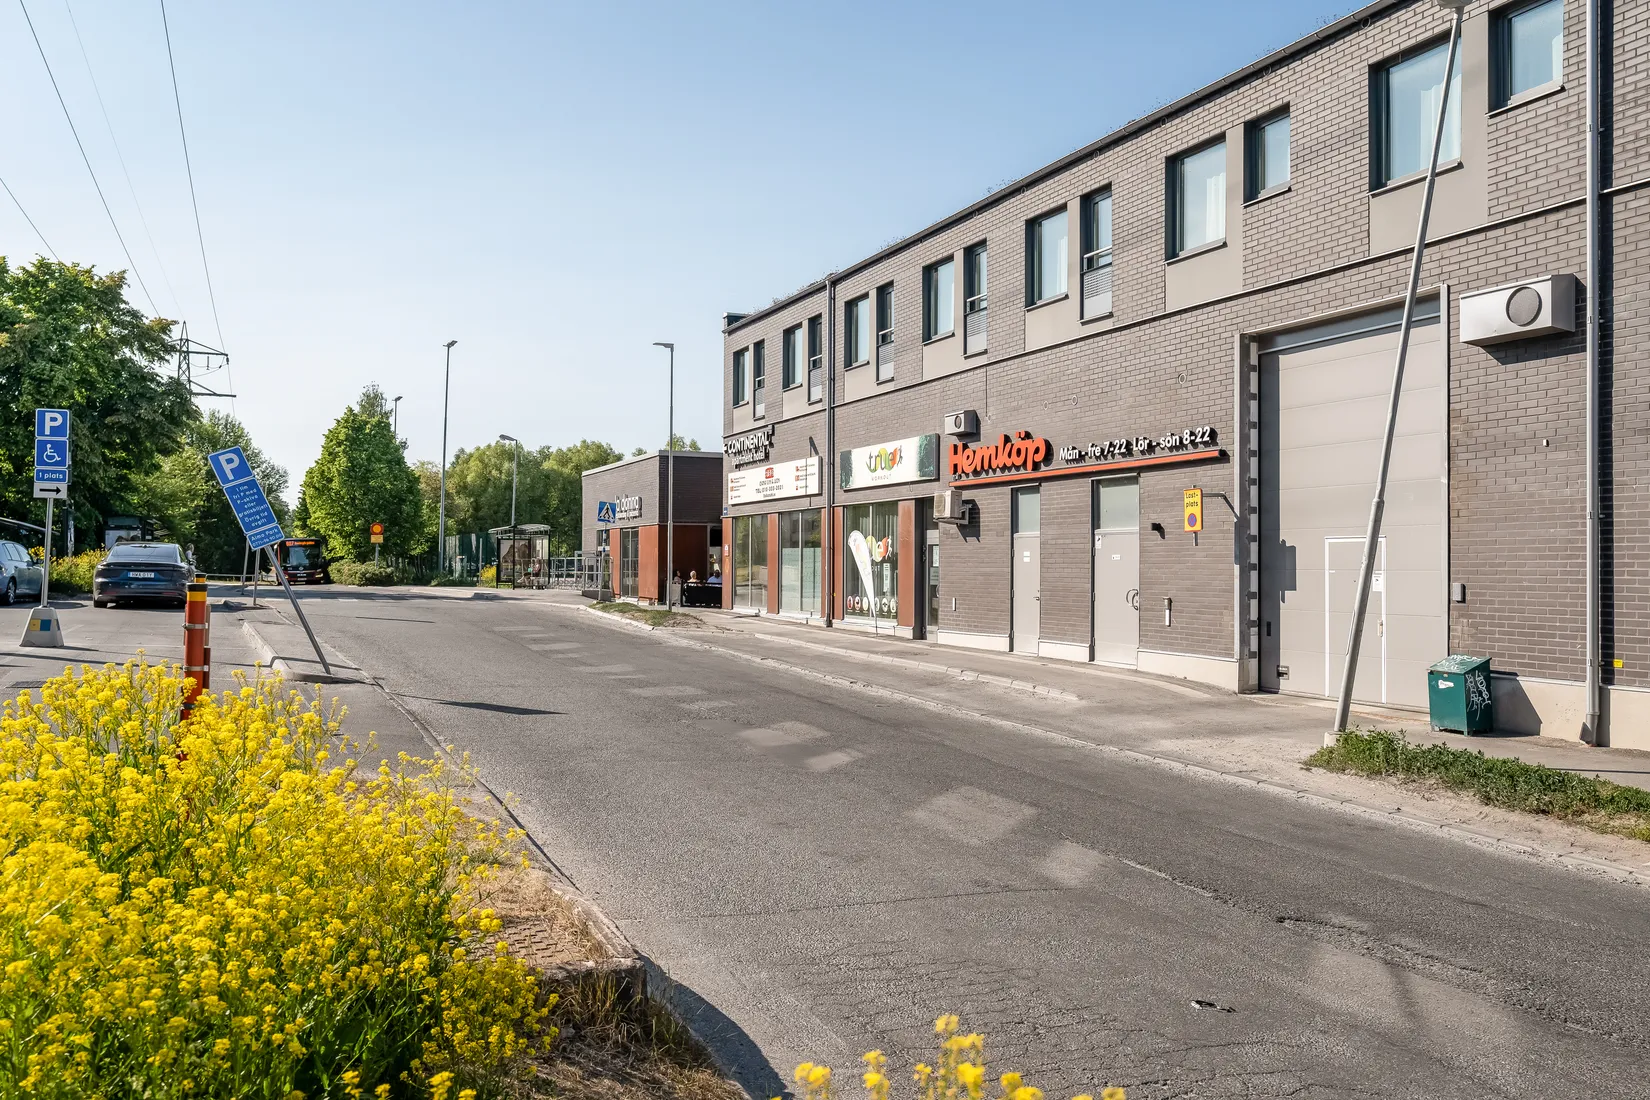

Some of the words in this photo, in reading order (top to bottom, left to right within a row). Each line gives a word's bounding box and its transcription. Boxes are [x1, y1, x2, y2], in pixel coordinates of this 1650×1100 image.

[45, 412, 63, 435] P
[727, 431, 769, 454] CONTINENTAL
[949, 430, 1046, 475] Hemköp
[1059, 446, 1079, 461] Mån
[1088, 443, 1101, 458] fre
[1103, 439, 1127, 455] 7-22
[1133, 437, 1149, 451] Lör
[1159, 432, 1180, 448] sön
[1183, 426, 1211, 445] 8-22
[218, 452, 240, 480] P
[1185, 501, 1199, 509] plats
